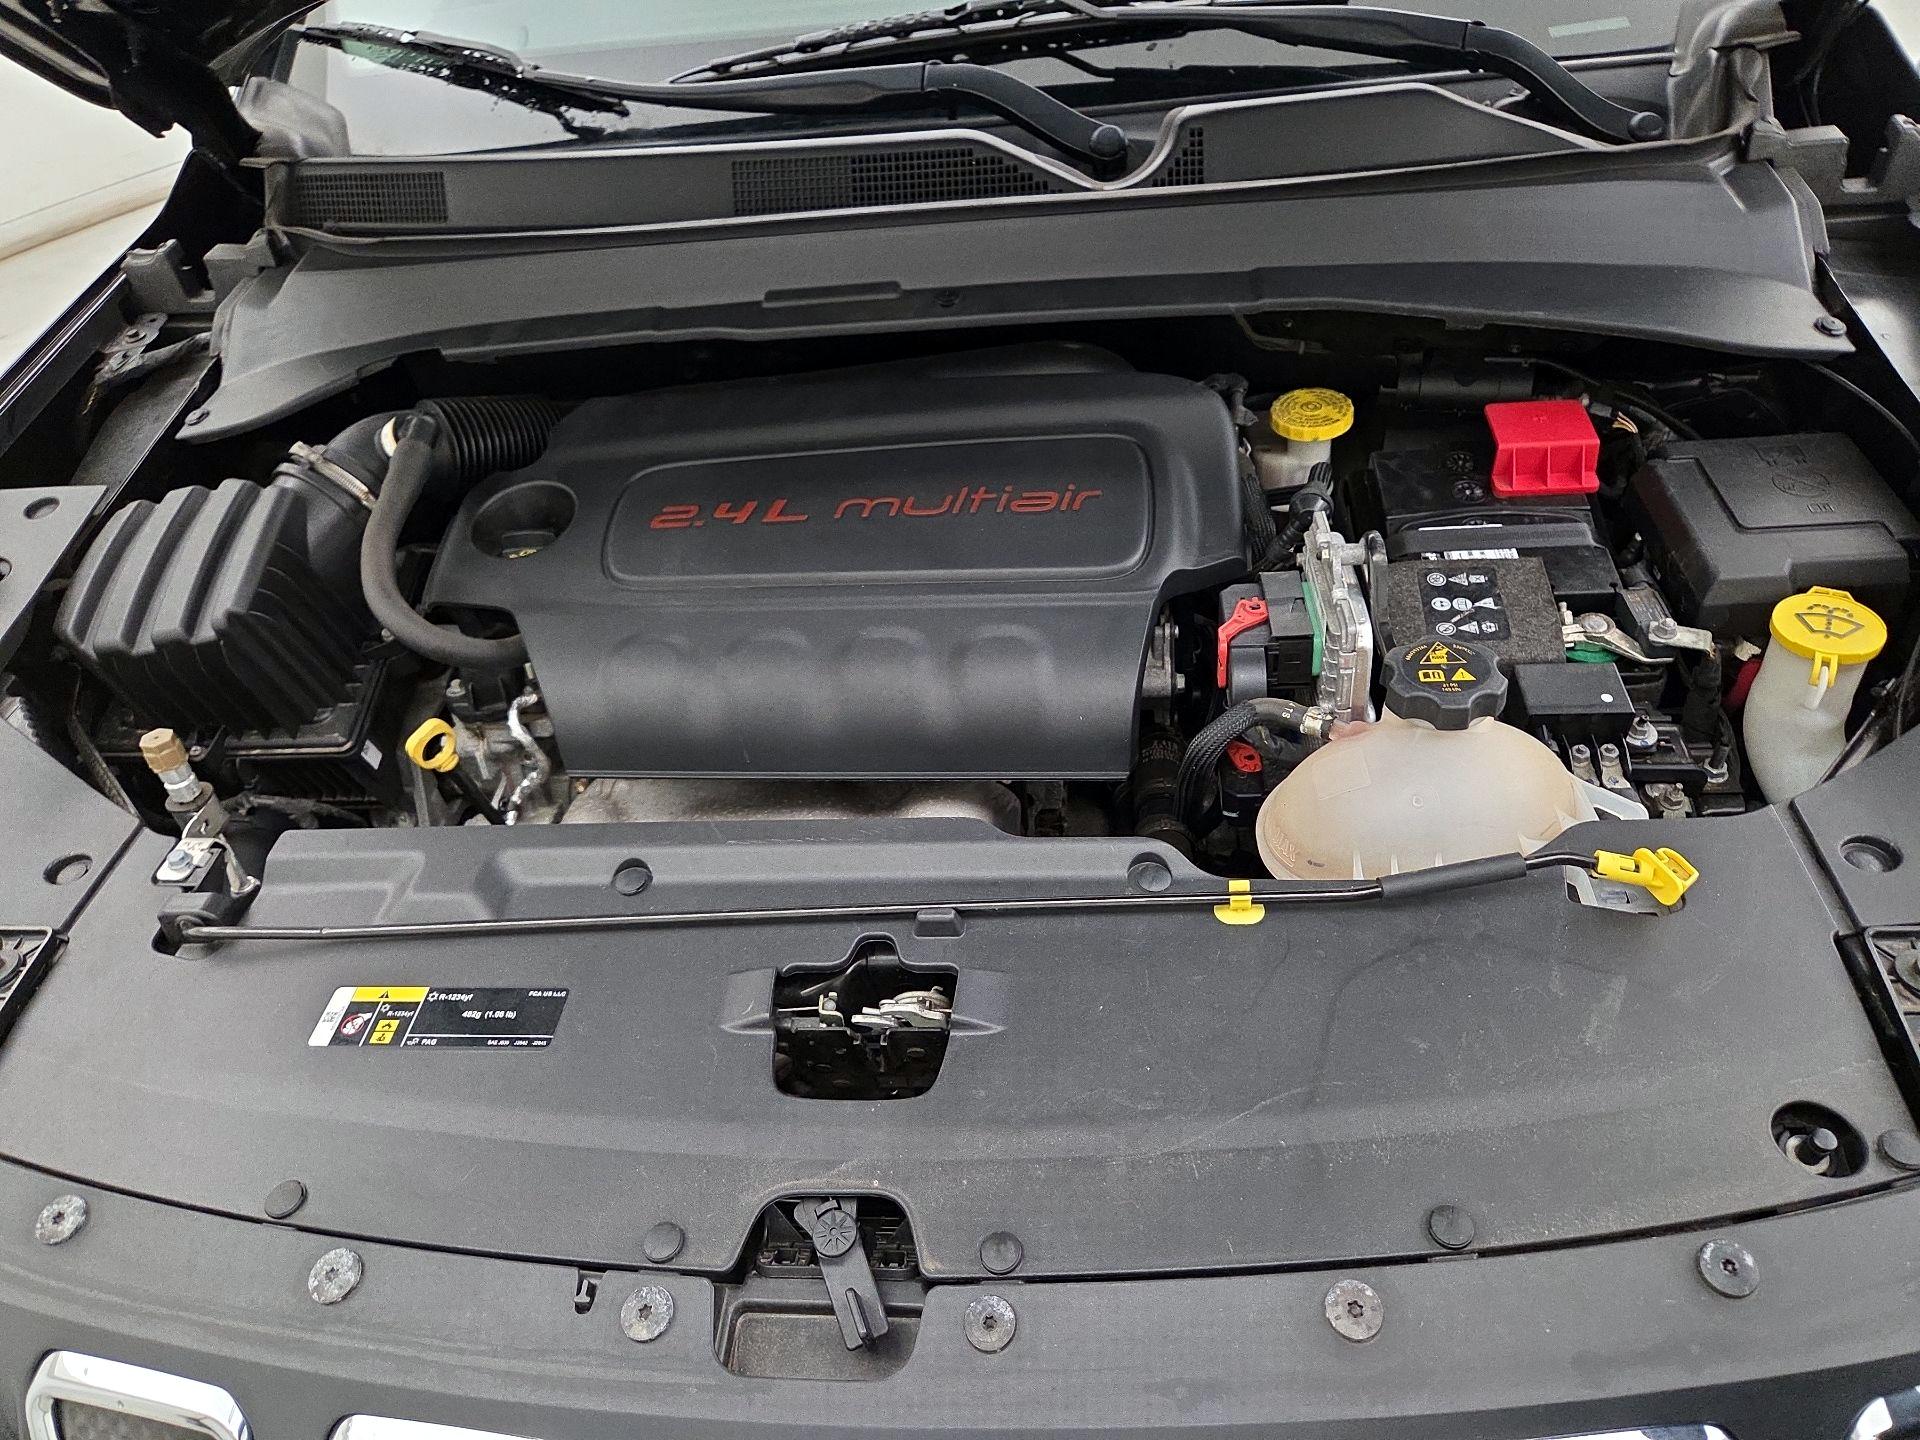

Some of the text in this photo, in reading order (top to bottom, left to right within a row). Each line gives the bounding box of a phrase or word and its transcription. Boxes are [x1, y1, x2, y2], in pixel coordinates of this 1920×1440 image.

[651, 484, 1103, 529] 2.4L multiair
[438, 993, 474, 1002] R-1234yf
